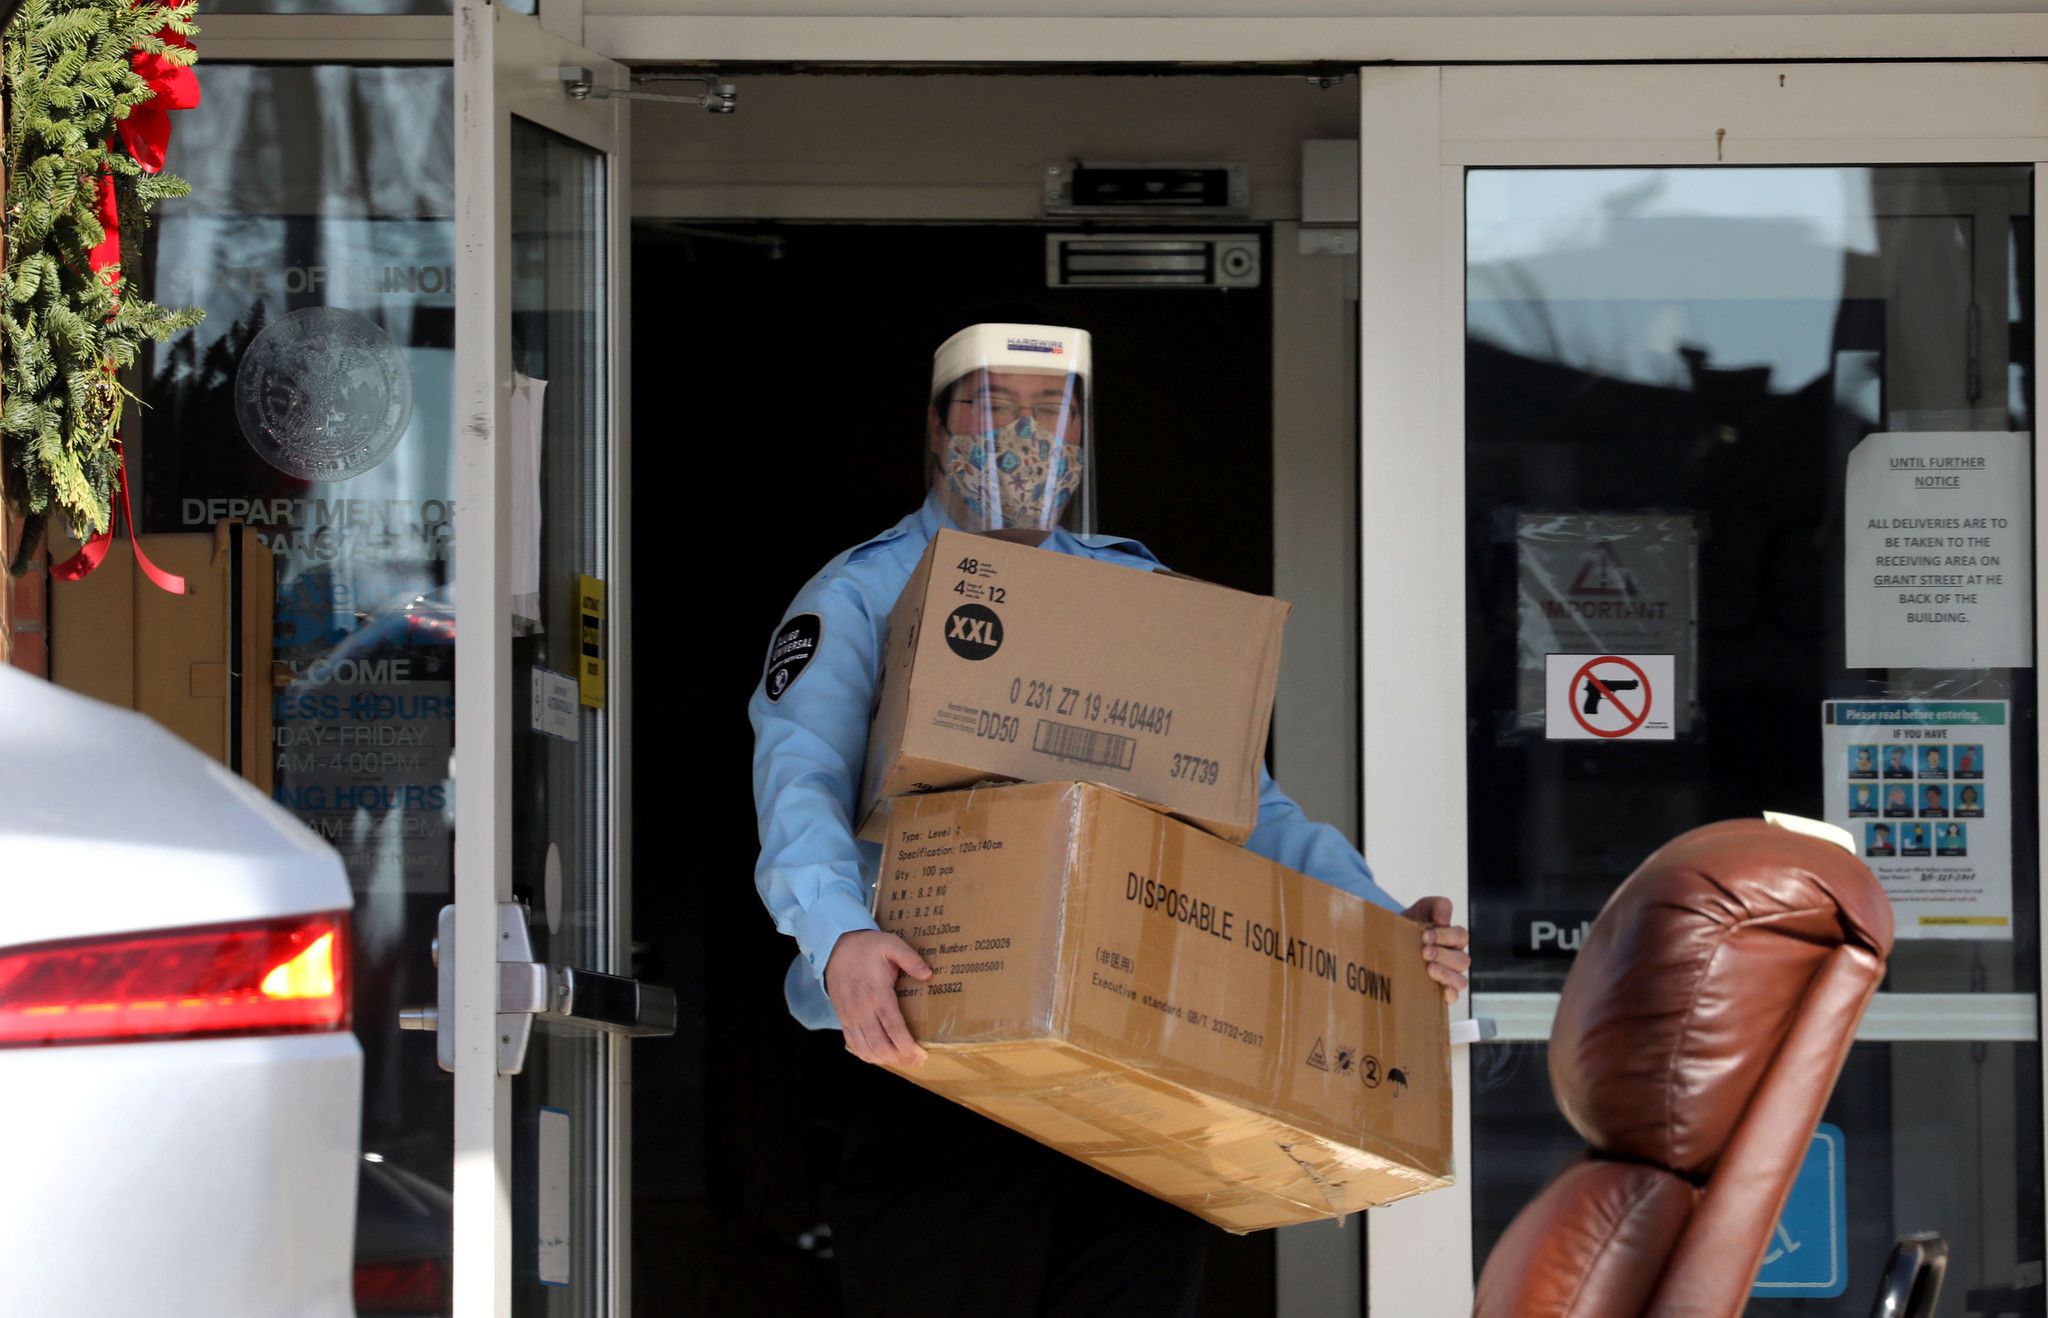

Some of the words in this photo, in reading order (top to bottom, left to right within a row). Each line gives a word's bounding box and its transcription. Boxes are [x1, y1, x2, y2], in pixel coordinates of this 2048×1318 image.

[283, 266, 326, 293] OF
[1890, 457, 1926, 470] UNTIL
[1929, 457, 1986, 470] FURTHER
[1914, 476, 1961, 489] NOTICE
[182, 498, 412, 526] DEPARTMENT
[1868, 518, 1890, 529] ALL
[1892, 518, 1960, 529] DELIVERIES
[1962, 518, 1987, 529] ARE
[1989, 518, 2008, 529] TO
[1885, 537, 1900, 548] BE
[1903, 537, 1944, 548] TAKEN
[1947, 537, 1965, 548] TO
[1966, 537, 1991, 548] THE
[956, 558, 978, 575] 48
[1876, 556, 1942, 567] RECEIVING
[1944, 556, 1978, 567] AREA
[1980, 556, 2000, 567] ON
[1873, 574, 1917, 587] GRANT
[1919, 574, 1964, 587] STREET
[1966, 574, 1984, 585] AT
[1985, 574, 2003, 585] HE
[953, 580, 966, 595] 4
[988, 586, 1006, 604] 12
[1899, 593, 1932, 604] BACK
[1934, 593, 1952, 604] OF
[1953, 593, 1978, 604] THE
[1906, 612, 1971, 624] BUILDING.
[948, 614, 998, 647] XXL
[1009, 677, 1022, 705] 0
[1024, 680, 1054, 711] 231
[275, 695, 341, 721] ESS
[349, 695, 456, 721] HOURS
[1845, 709, 1877, 721] Please
[1878, 709, 1901, 721] read
[1902, 709, 1934, 721] before
[1935, 709, 1981, 722] entering.
[977, 709, 1020, 744] DD50
[1893, 729, 1902, 739] IF
[1904, 729, 1922, 739] YOU
[1924, 729, 1949, 739] HAVE
[272, 726, 430, 747] DAY-FRIDAY
[1170, 752, 1220, 786] 37739
[335, 784, 446, 811] HOURS
[902, 831, 924, 843] Type:
[928, 827, 951, 840] Level
[898, 846, 957, 862] Specification:
[922, 865, 937, 877] 100
[939, 866, 955, 876] pcs
[936, 885, 947, 896] KG
[933, 905, 945, 916] KG
[1126, 872, 1234, 941] DISPOSABLE
[1245, 920, 1337, 983] ISOLATION
[1346, 962, 1392, 1004] GOWN
[1530, 920, 1594, 950] Pul
[1091, 971, 1137, 1000] Executive
